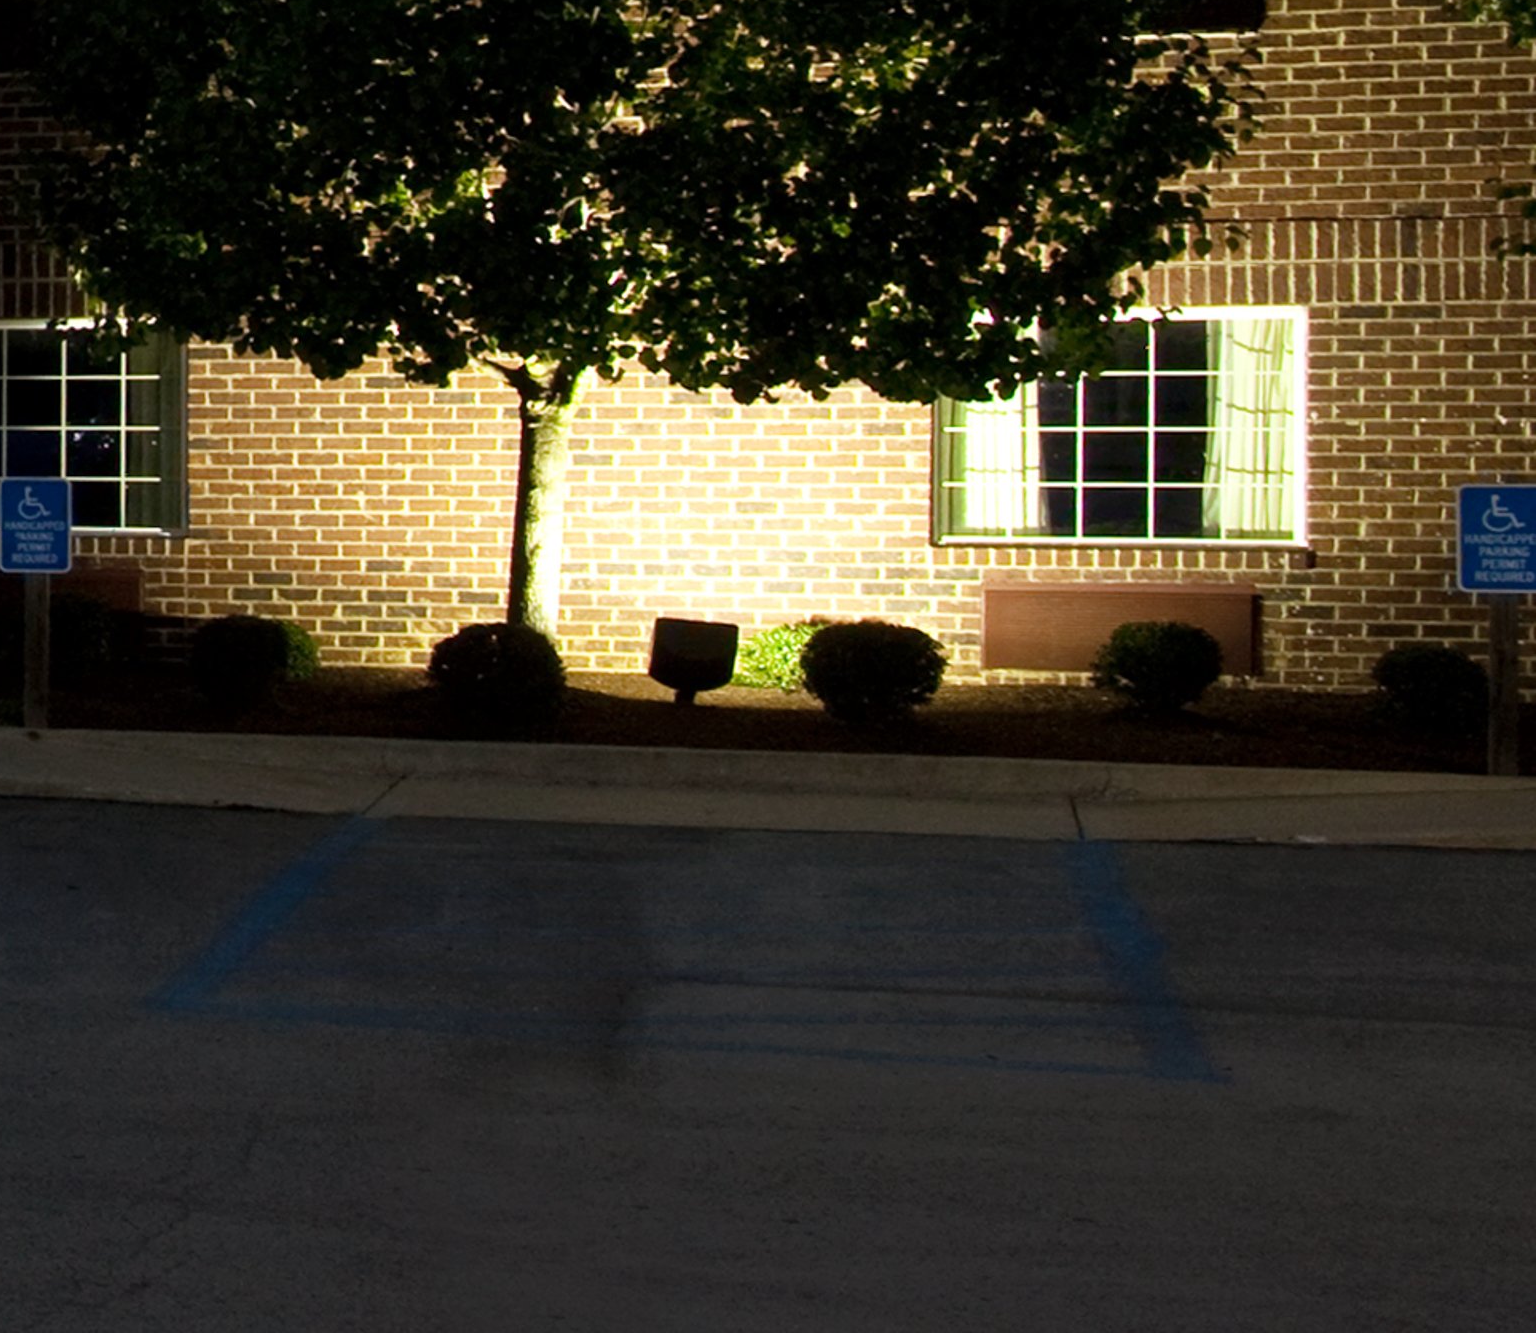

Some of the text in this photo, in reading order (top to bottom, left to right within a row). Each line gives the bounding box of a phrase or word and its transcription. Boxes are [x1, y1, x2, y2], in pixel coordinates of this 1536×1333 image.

[1464, 533, 1536, 545] HANDICAPPE
[16, 542, 52, 552] PERMIT
[1478, 546, 1531, 557] PARKING
[10, 553, 59, 564] REQUIRED
[1481, 558, 1526, 570] PERMIT
[1474, 570, 1535, 583] REQUIRED
